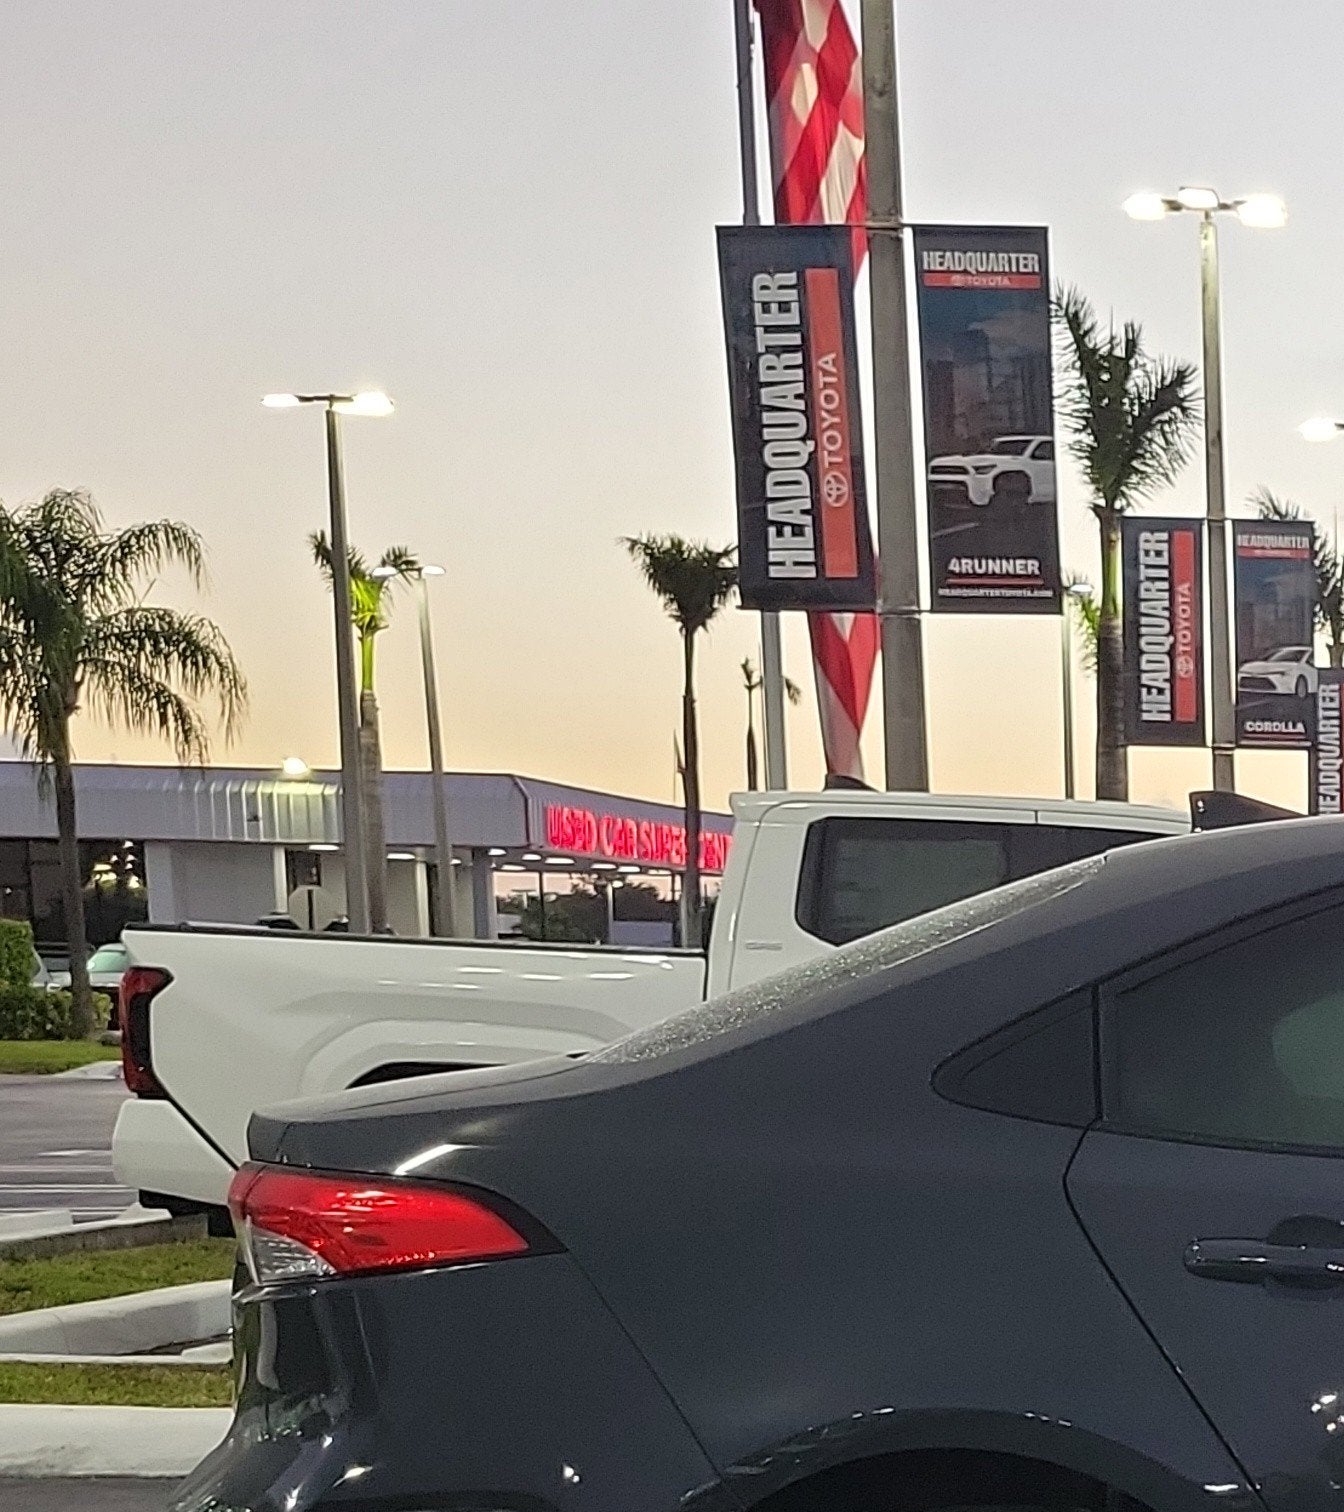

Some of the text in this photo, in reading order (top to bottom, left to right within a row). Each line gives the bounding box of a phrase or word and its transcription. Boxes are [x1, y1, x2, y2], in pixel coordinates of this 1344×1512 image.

[923, 251, 1040, 273] HEADQUARTER
[966, 275, 1012, 286] TOYOTA
[752, 271, 817, 579] HEADQUARTER
[817, 352, 844, 468] TOYOTA
[1237, 534, 1310, 549] HEADQUARTER
[948, 557, 1041, 575] 4RUNNER
[1139, 531, 1174, 722] HEADQUARTER
[1176, 582, 1191, 651] TOYOTA
[1244, 721, 1305, 733] COROLLA
[547, 806, 597, 852] USED
[601, 815, 639, 859] CAR
